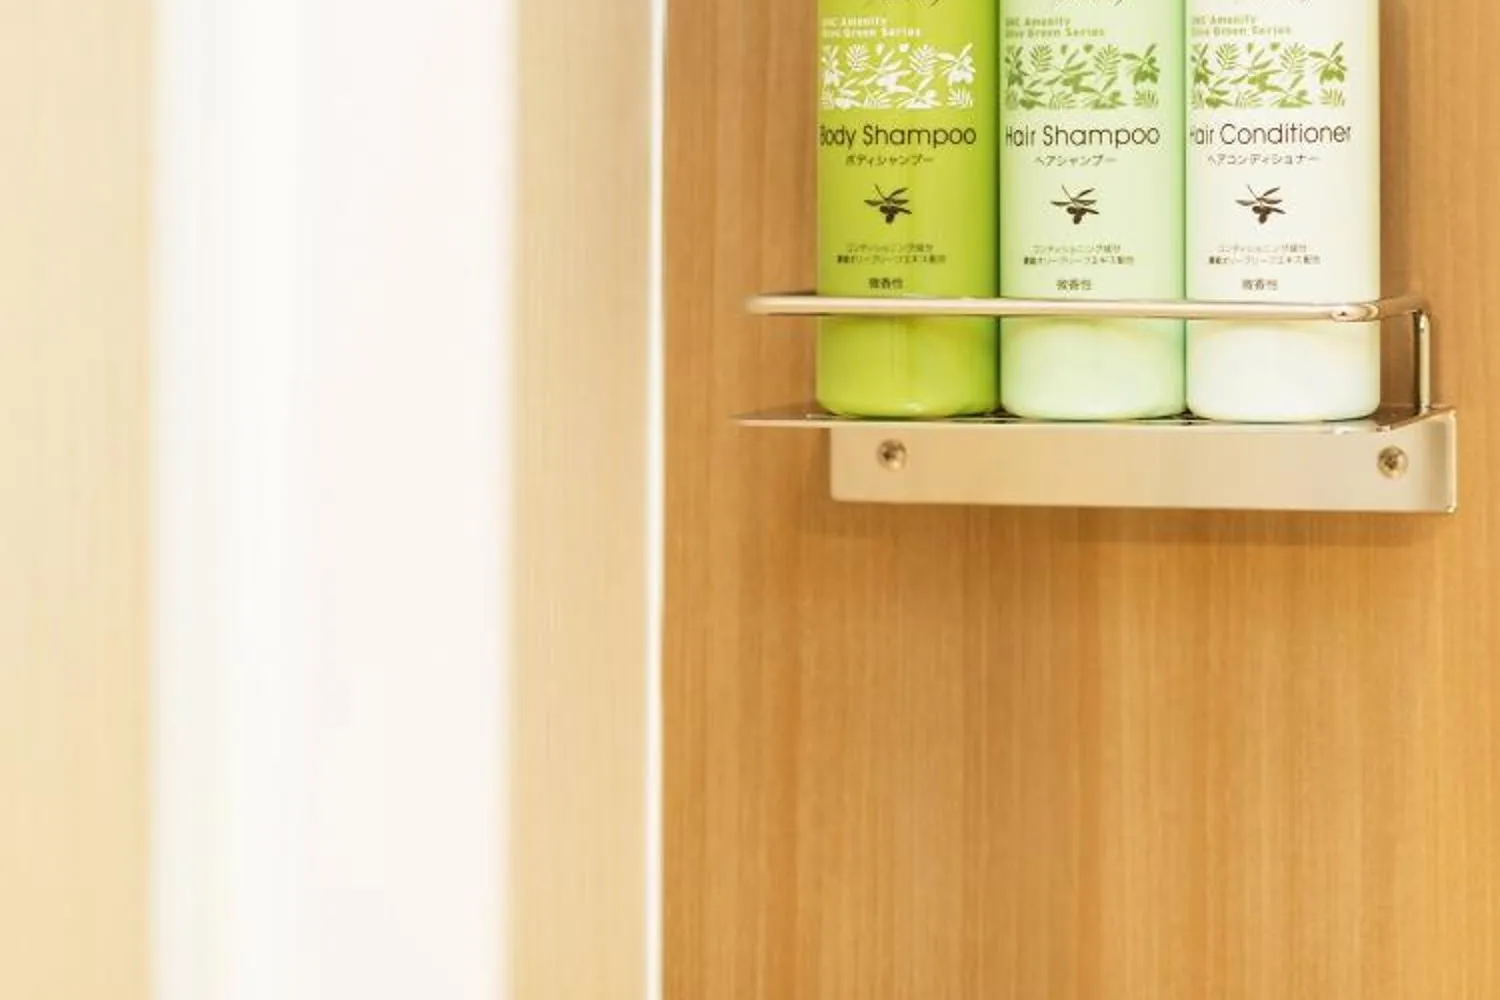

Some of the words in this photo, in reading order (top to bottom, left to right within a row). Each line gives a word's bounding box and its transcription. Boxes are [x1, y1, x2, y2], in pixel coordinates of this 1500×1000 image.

[863, 124, 977, 149] Shampoo
[1005, 124, 1036, 147] Hair
[1042, 124, 1160, 148] Shampoo
[1219, 123, 1352, 146] Conditioner
[845, 153, 934, 167] ボディシャンプー
[1034, 154, 1118, 167] ヘアシャンプー
[1207, 152, 1321, 166] ヘアコンディショナー
